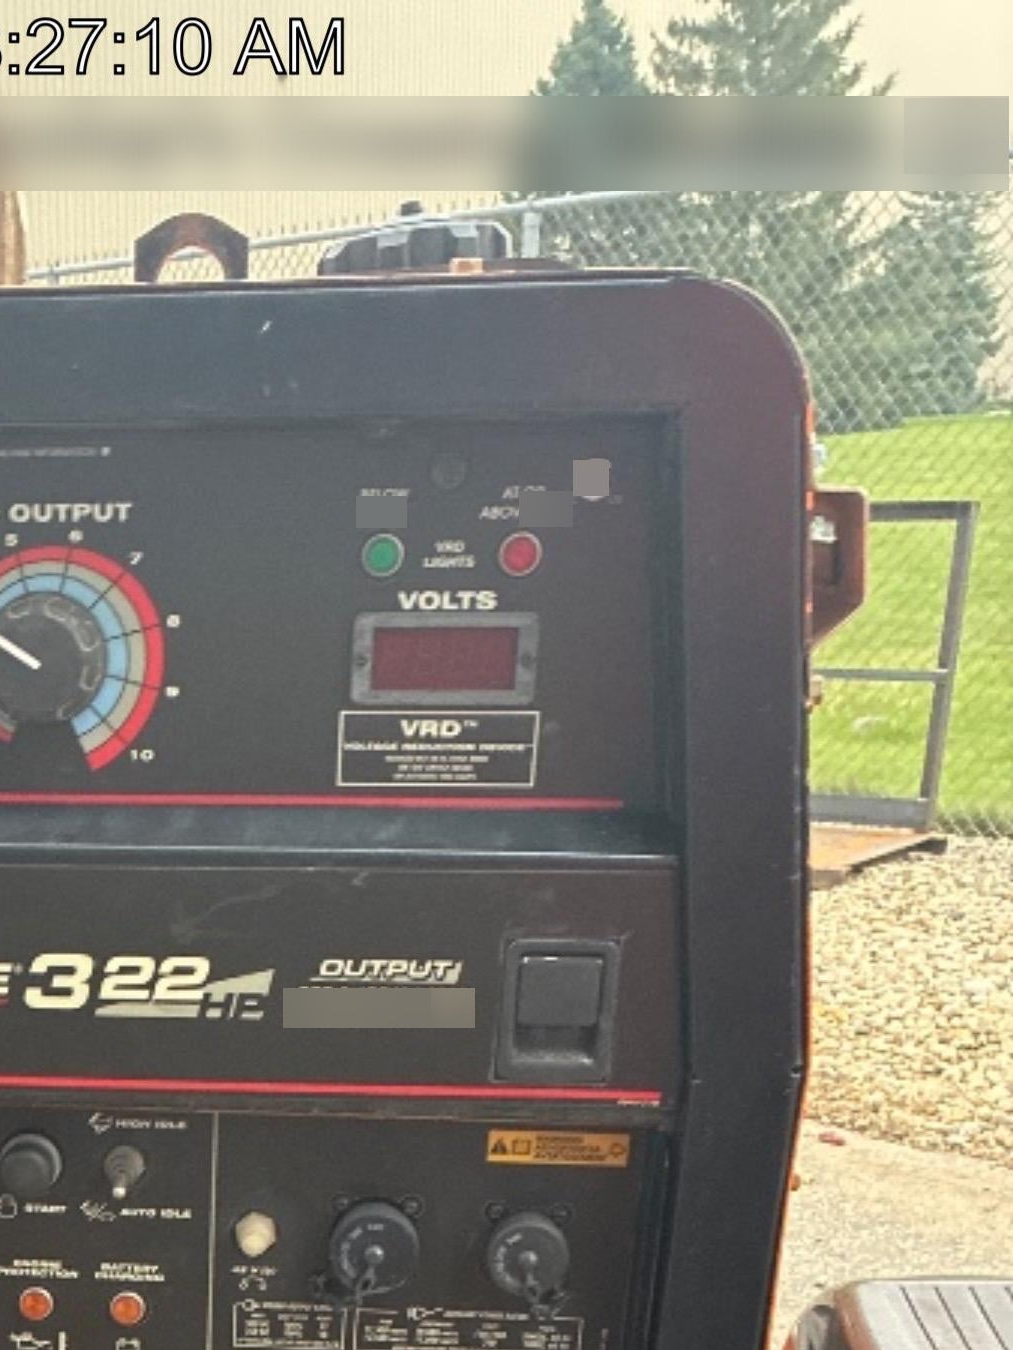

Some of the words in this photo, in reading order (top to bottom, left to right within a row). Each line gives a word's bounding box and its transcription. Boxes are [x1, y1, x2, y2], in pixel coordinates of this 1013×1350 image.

[8, 502, 132, 523] OUTPUT
[4, 532, 18, 547] 5
[129, 550, 143, 565] 7
[397, 590, 498, 611] VOLTS
[130, 748, 155, 762] 10
[318, 959, 457, 980] OUTPUT
[24, 952, 211, 1010] 322
[24, 1203, 67, 1214] START
[119, 1207, 157, 1218] AUTO
